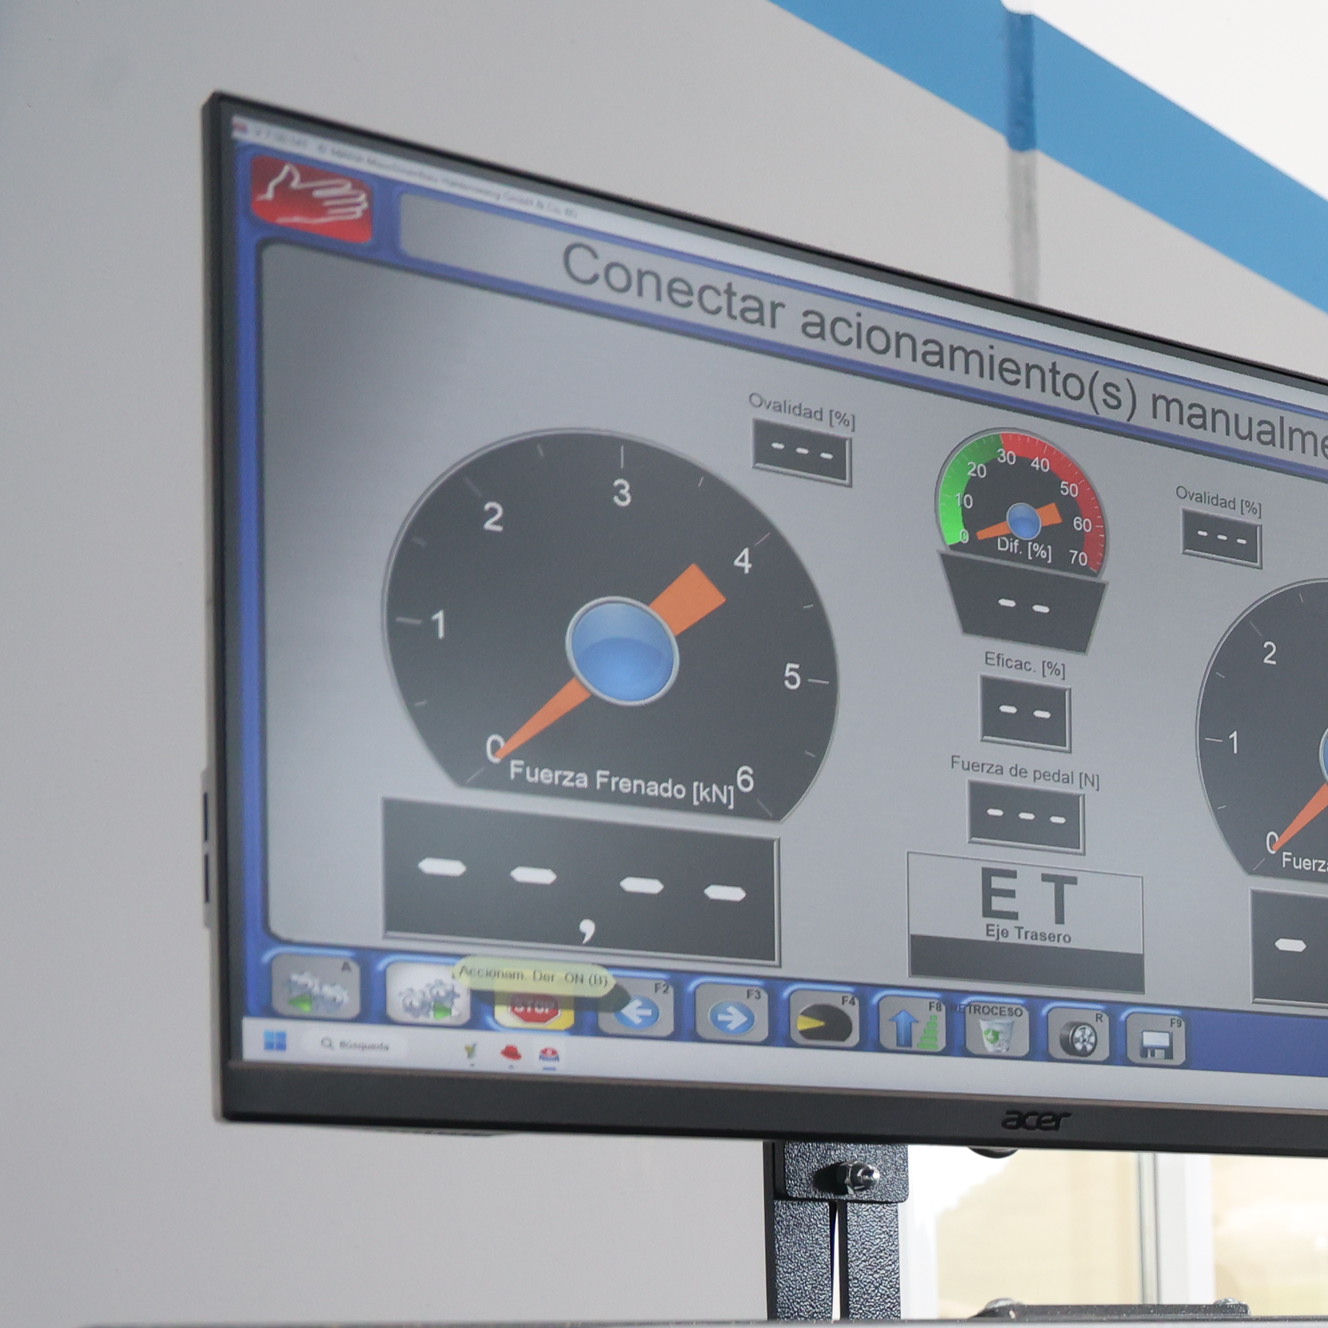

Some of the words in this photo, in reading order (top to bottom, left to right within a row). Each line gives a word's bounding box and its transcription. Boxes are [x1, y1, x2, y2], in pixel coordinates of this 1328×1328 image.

[562, 242, 786, 329] Conectar
[801, 310, 1137, 423] acionamiento(s)
[748, 392, 824, 422] Ovalidad
[829, 408, 857, 432] [%]
[997, 449, 1016, 465] 30
[1031, 457, 1050, 473] 40
[967, 462, 987, 478] 20
[613, 479, 632, 507] 3
[956, 493, 974, 509] 10
[1060, 481, 1079, 498] 50
[1176, 484, 1236, 511] Ovalidad
[1240, 498, 1262, 519] [%]
[484, 502, 504, 532] 2
[1073, 517, 1092, 533] 60
[959, 529, 970, 544] 0
[734, 548, 753, 575] 4
[997, 537, 1023, 556] Dif.
[1028, 542, 1053, 563] [%]
[1069, 550, 1088, 566] 70
[431, 610, 446, 639] 1
[1263, 641, 1277, 665] 2
[784, 663, 802, 690] 5
[984, 651, 1037, 673] Eficac.
[1042, 660, 1066, 681] [%]
[486, 734, 506, 763] 0
[1229, 730, 1239, 755] 1
[509, 759, 588, 789] Fuerza
[596, 770, 686, 800] Frenado
[693, 782, 735, 809] [kN]
[737, 766, 755, 793] 6
[951, 755, 1004, 777] Fuerza
[1009, 764, 1029, 778] de
[1033, 768, 1074, 785] pedal
[1079, 772, 1100, 791] [N]
[1266, 831, 1279, 854] 0
[986, 924, 1009, 940] Eje
[1014, 926, 1072, 944] Trasero
[654, 982, 670, 994] F2
[746, 989, 762, 1001] F3
[841, 996, 856, 1007] F4
[928, 1002, 942, 1012] F8
[1095, 1013, 1104, 1023] R
[1170, 1018, 1183, 1028] F9
[1001, 1110, 1072, 1132] acer
